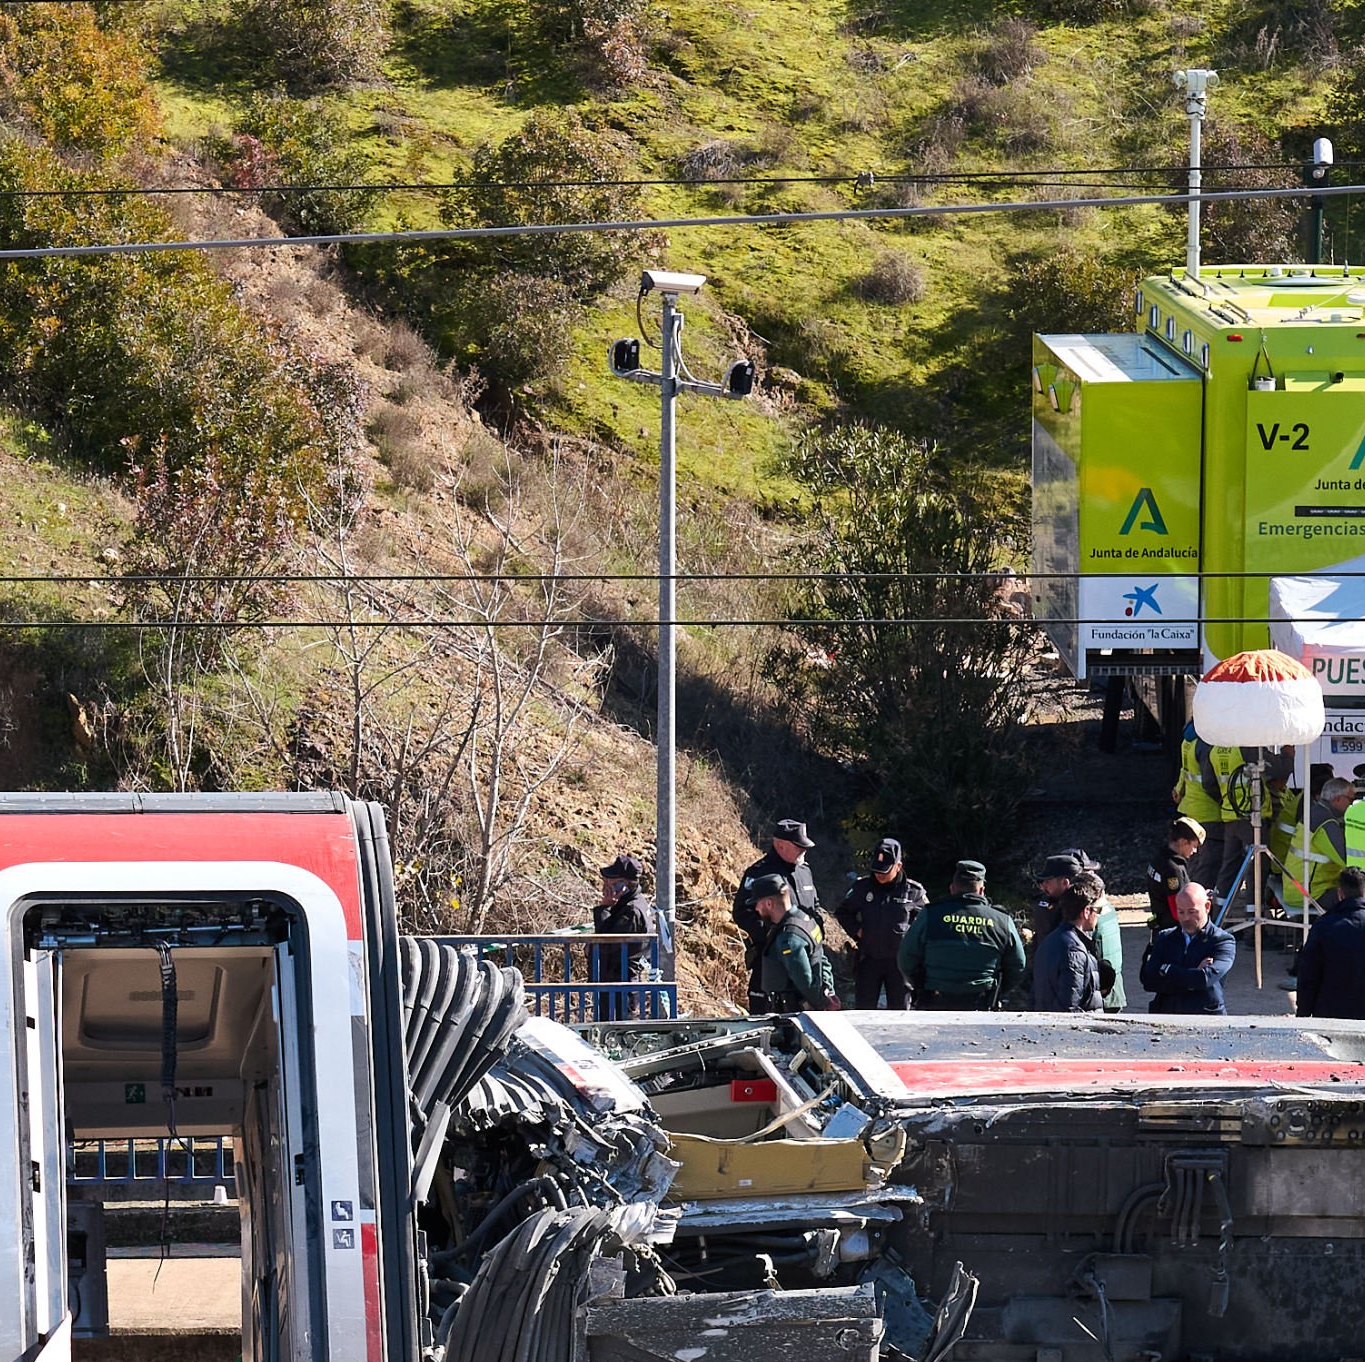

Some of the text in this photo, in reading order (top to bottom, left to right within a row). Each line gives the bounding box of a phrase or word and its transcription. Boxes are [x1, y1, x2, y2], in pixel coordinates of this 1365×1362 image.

[1256, 423, 1310, 450] V-2
[1315, 478, 1351, 490] Junta
[1089, 546, 1198, 558] Junta de Andalucía
[1091, 628, 1146, 640] Fundación
[943, 914, 995, 928] GUARDIA
[955, 924, 983, 935] CIVIL
